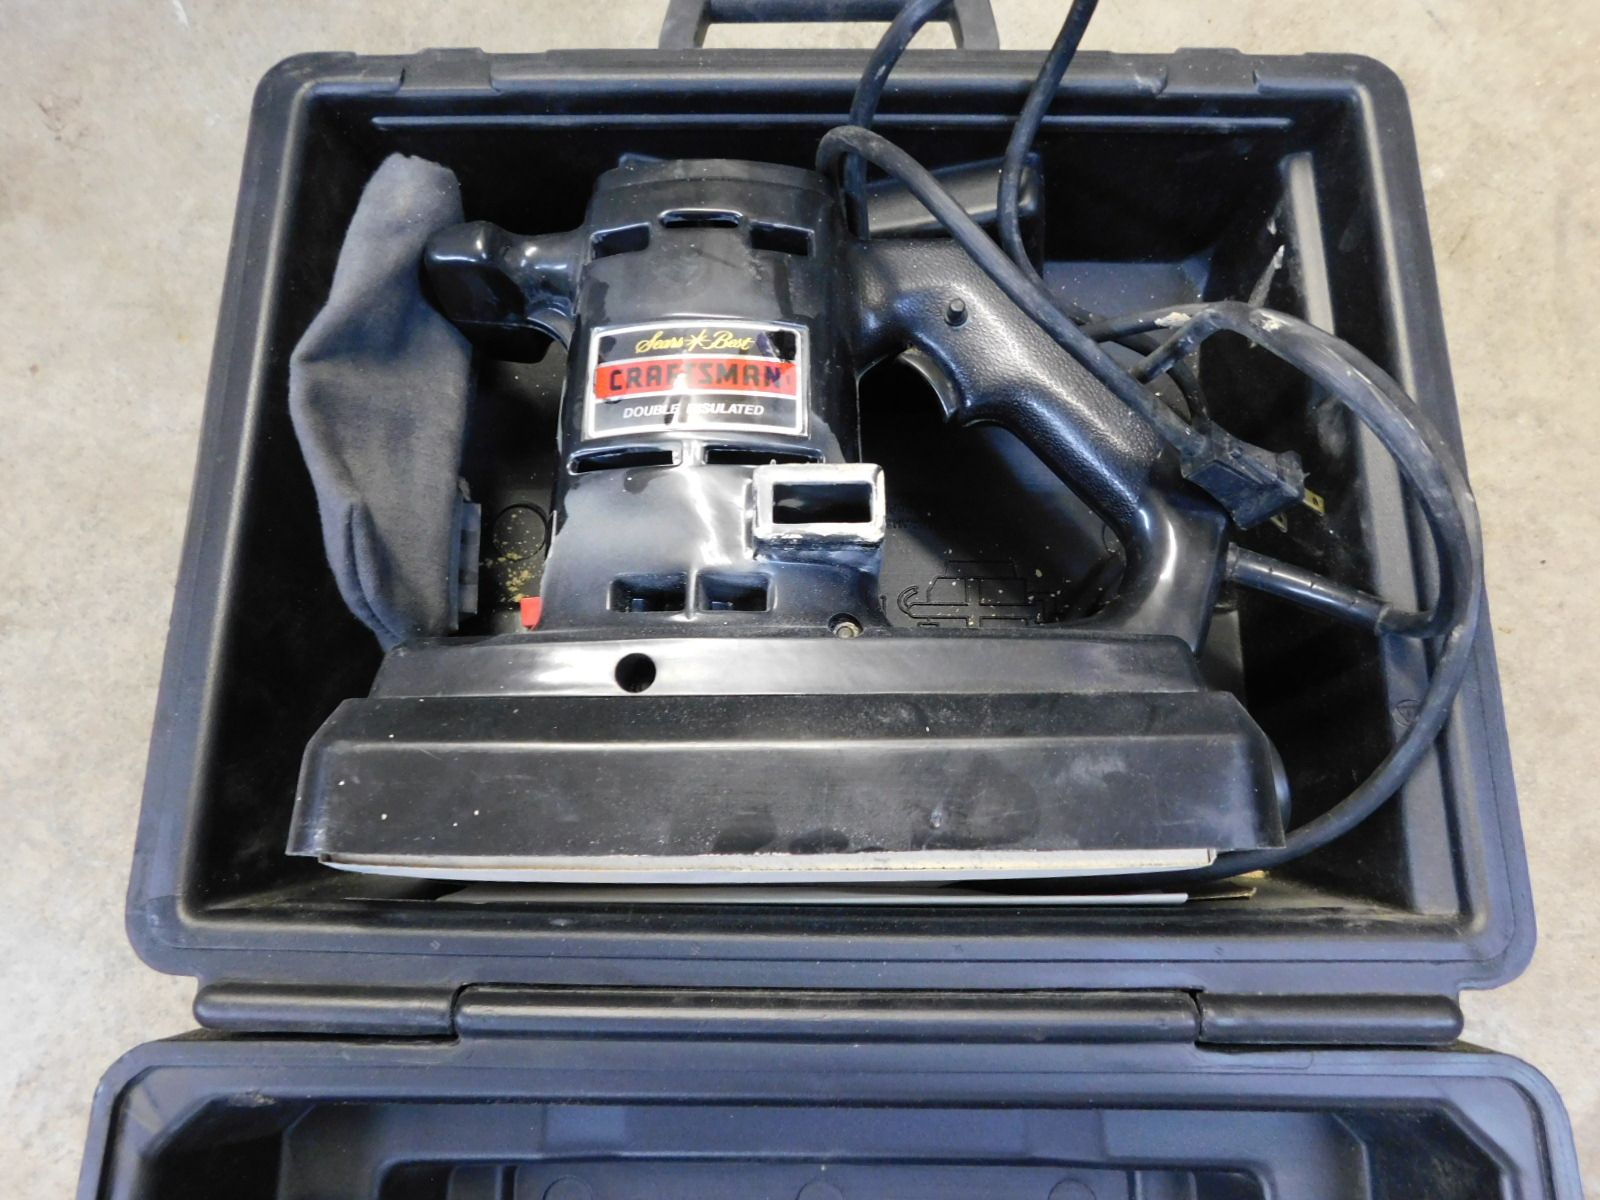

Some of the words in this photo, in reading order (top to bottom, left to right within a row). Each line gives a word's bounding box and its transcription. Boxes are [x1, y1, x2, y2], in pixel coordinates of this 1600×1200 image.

[635, 331, 684, 353] Sears
[703, 330, 752, 350] Best
[609, 362, 781, 391] CRAFTSMAN
[623, 403, 680, 418] DOUBLE
[686, 402, 765, 416] ISULATED
